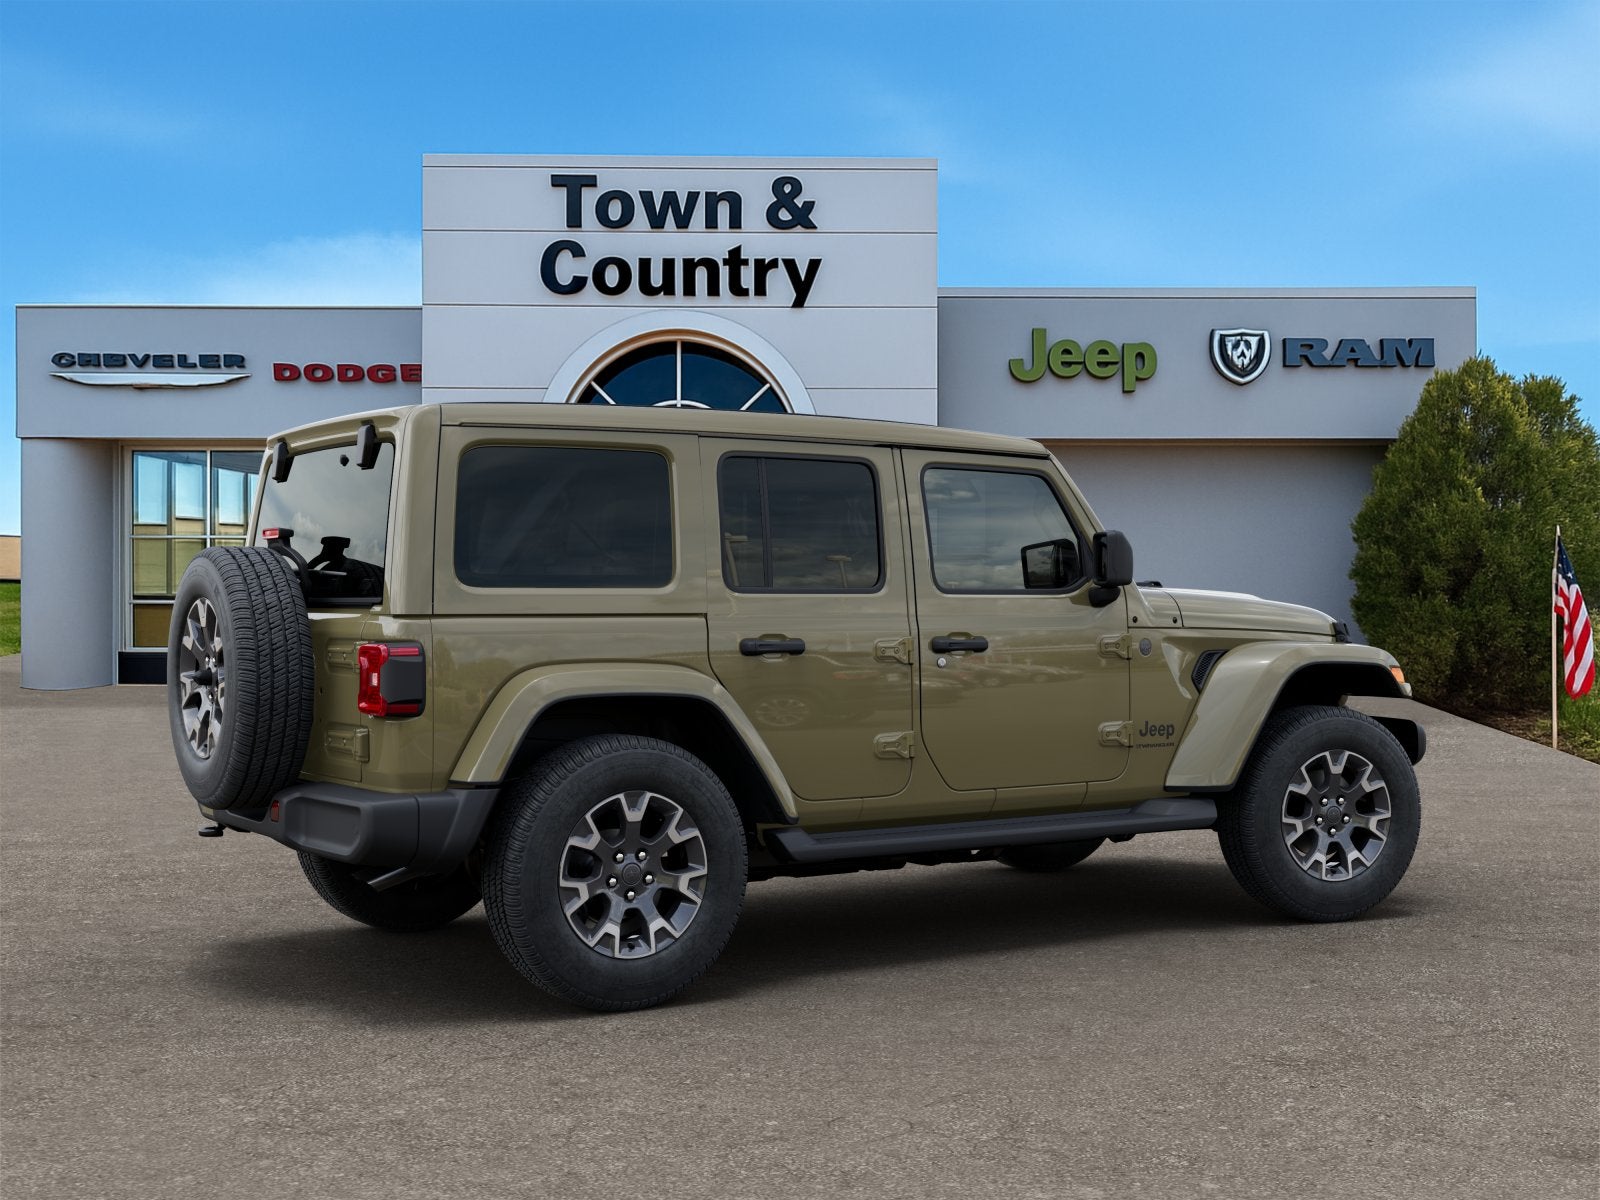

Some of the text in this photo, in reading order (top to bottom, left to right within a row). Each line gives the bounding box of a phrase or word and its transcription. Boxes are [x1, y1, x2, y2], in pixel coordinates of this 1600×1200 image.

[550, 174, 818, 230] Town &
[539, 239, 823, 308] Country
[273, 363, 422, 383] DODGE
[1008, 327, 1157, 392] Jeep
[1282, 337, 1435, 368] RAM
[1139, 720, 1175, 739] Jeep
